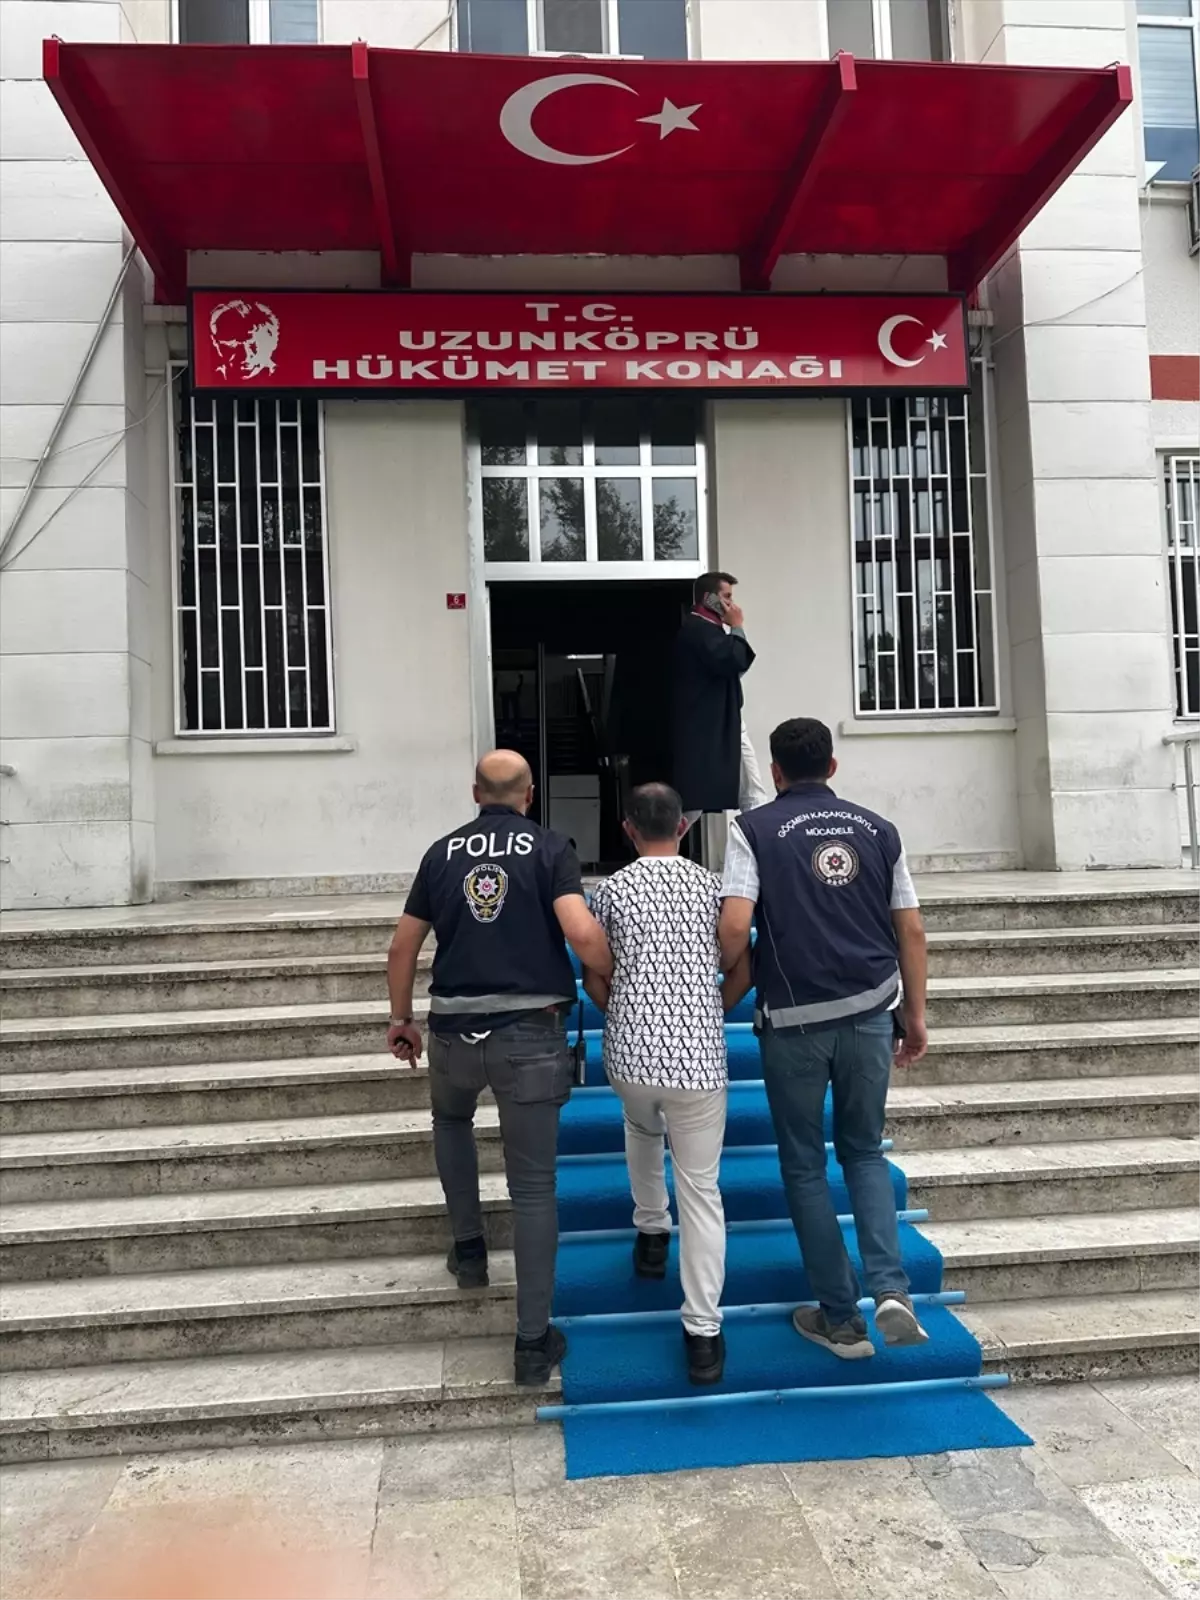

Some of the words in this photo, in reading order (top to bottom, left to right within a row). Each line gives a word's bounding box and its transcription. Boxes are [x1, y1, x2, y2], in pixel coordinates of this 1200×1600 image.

[525, 303, 633, 322] T.C.
[400, 327, 759, 350] UZUNKÖPRÜ
[313, 355, 607, 380] HÜKÜMET
[626, 356, 842, 379] KONAĞI
[805, 826, 854, 836] MÜCADELE
